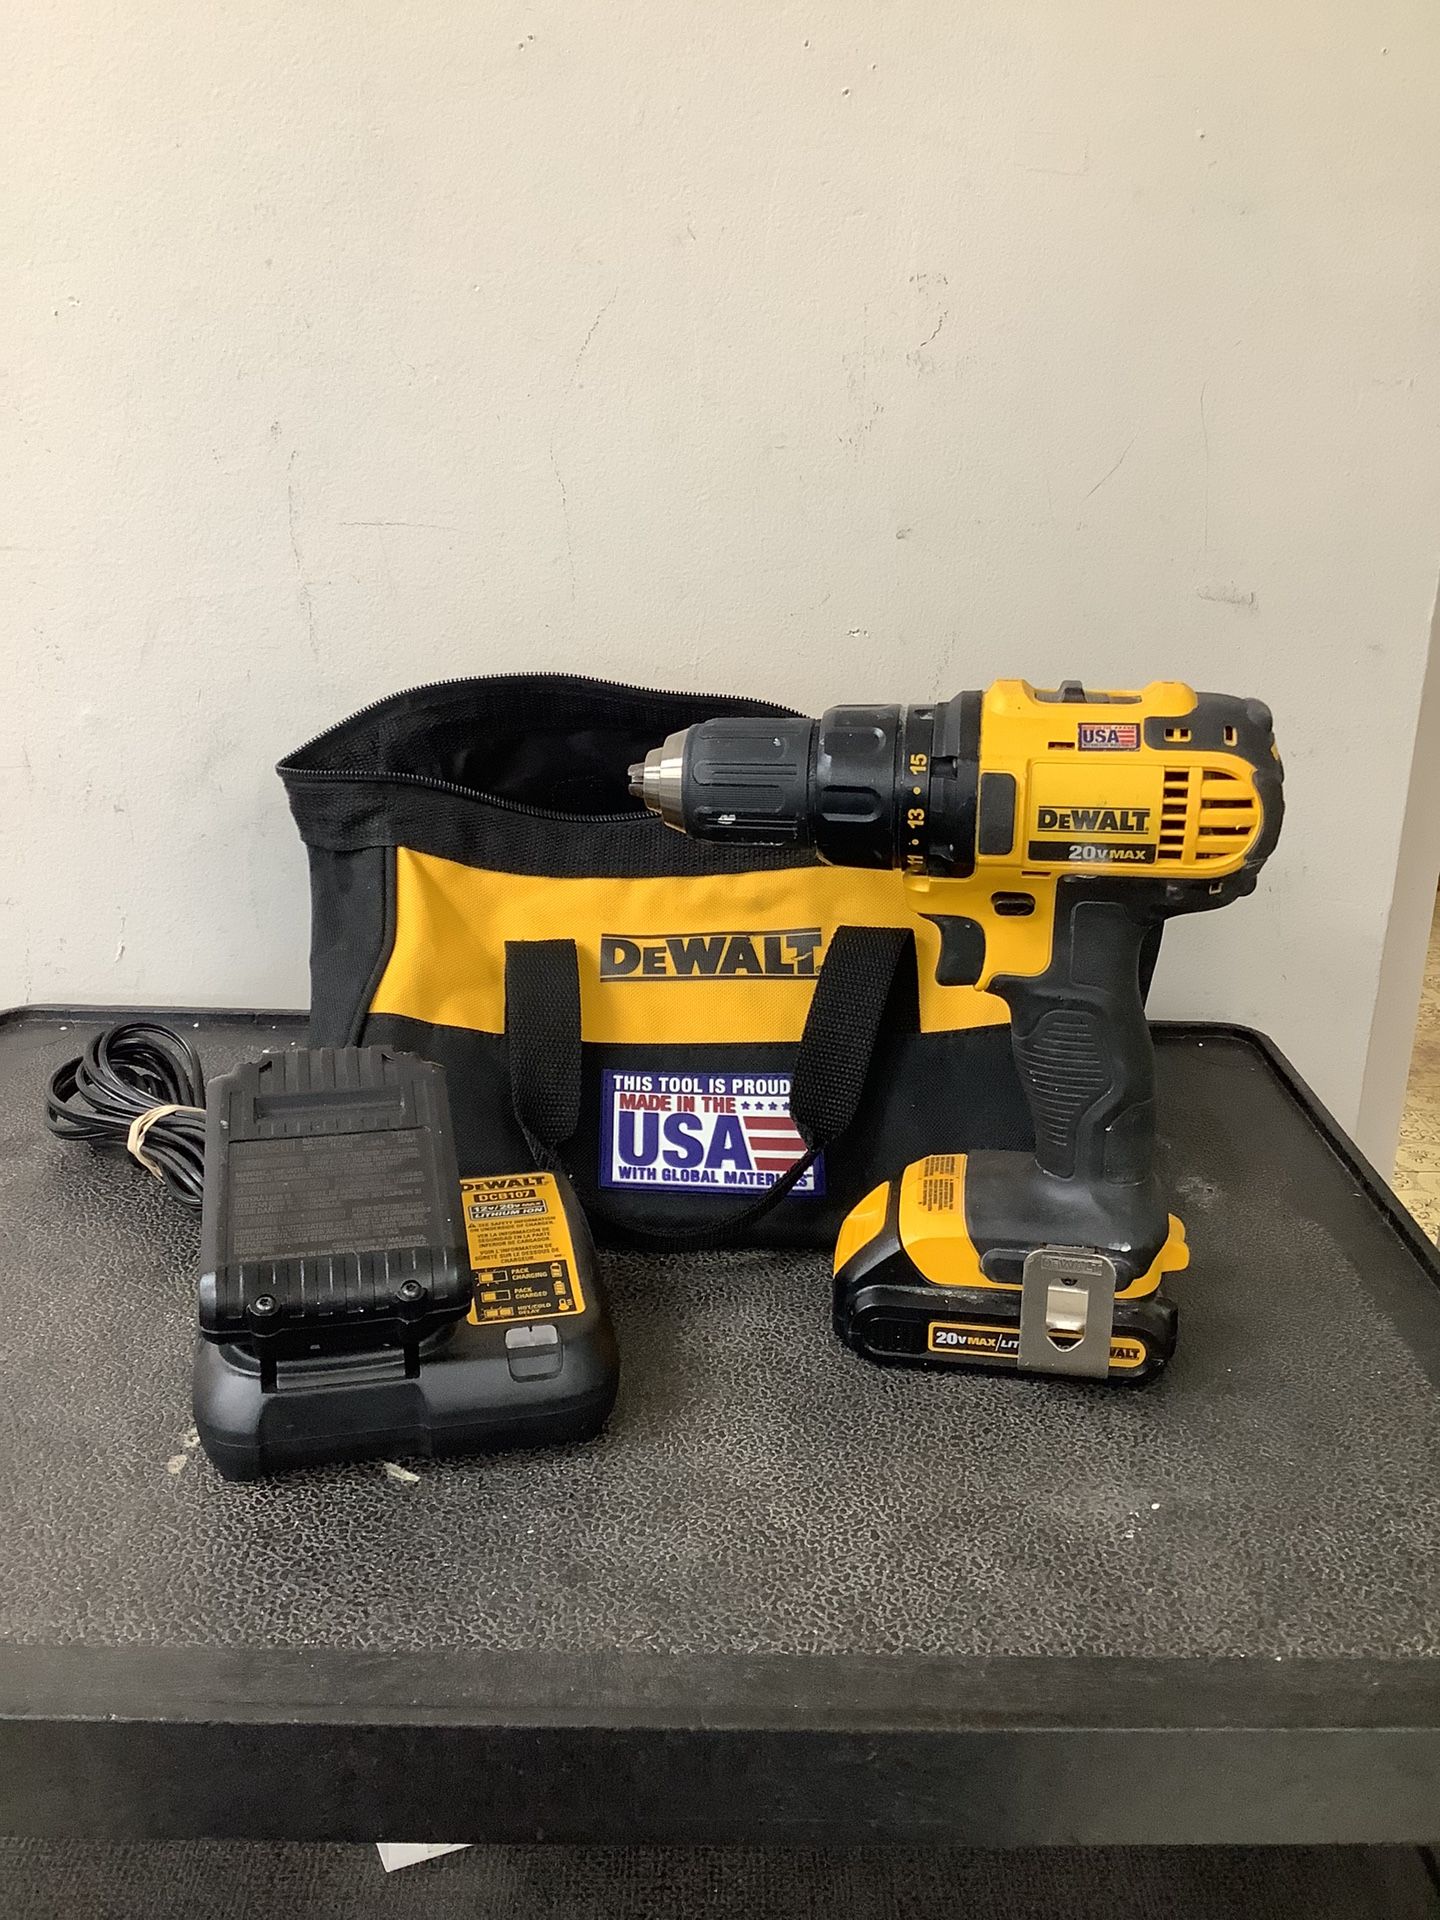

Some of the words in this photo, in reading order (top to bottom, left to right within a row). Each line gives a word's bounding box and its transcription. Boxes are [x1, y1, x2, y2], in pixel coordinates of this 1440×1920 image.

[1082, 729, 1119, 743] USA
[910, 753, 928, 775] 15
[907, 808, 925, 829] 13
[613, 1075, 653, 1091] THIS
[659, 1077, 703, 1093] TOOL
[709, 1078, 725, 1093] IS
[732, 1079, 791, 1095] PROUD
[619, 1094, 672, 1110] MADE
[676, 1096, 696, 1112] IN
[703, 1097, 736, 1113] THE
[618, 1110, 753, 1171] USA
[618, 1166, 657, 1181] WITH
[661, 1168, 719, 1184] GLOBAL
[723, 1171, 808, 1187] MATERS
[479, 1191, 530, 1202] DCB107
[512, 1271, 548, 1281] CHARGING
[515, 1291, 548, 1299] CHARGED
